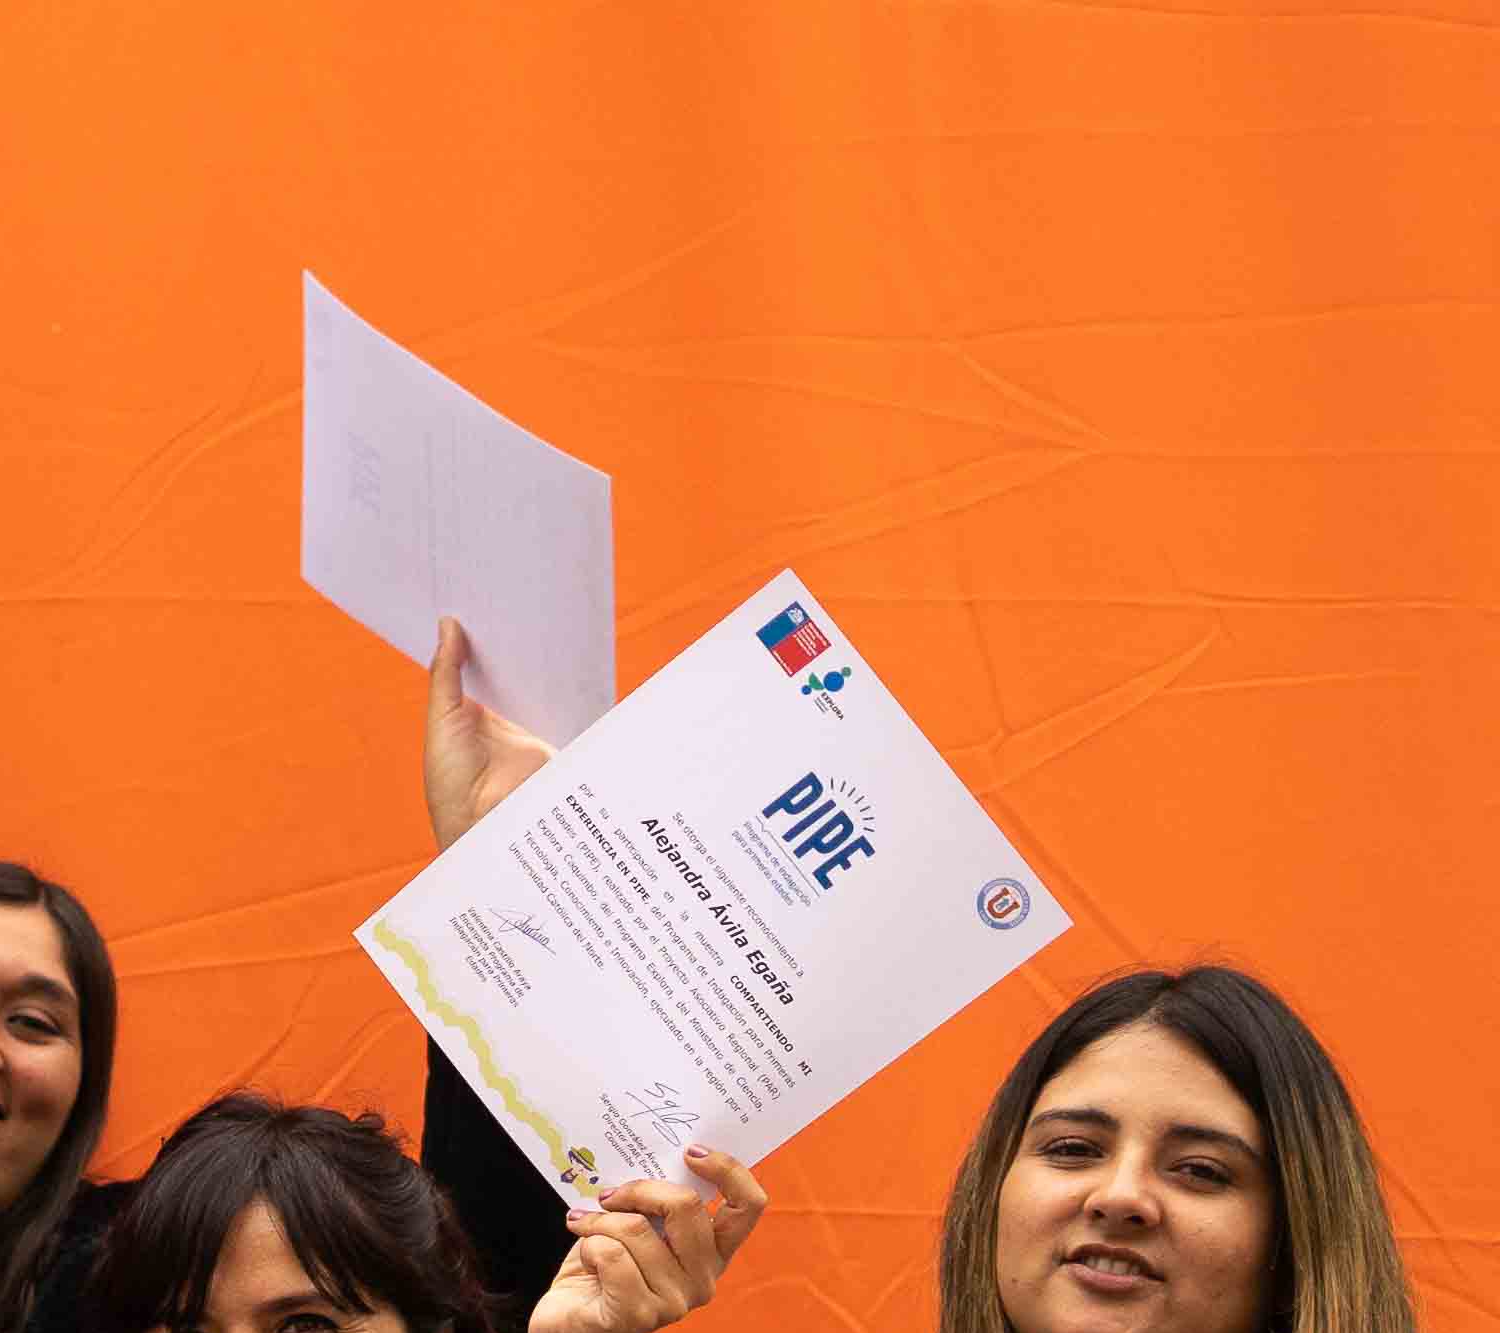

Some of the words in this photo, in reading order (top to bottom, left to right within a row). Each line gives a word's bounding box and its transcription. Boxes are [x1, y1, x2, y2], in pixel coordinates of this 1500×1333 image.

[820, 691, 844, 721] EXPLORA
[640, 818, 712, 902] Alejandra
[708, 905, 752, 948] Ávila
[745, 949, 794, 1005] Egaña
[671, 811, 685, 826] Se
[683, 825, 707, 855] otorga
[705, 855, 717, 865] el
[713, 864, 747, 904] siguiente
[743, 904, 798, 969] reconocimiento
[762, 772, 876, 890] PIPE
[565, 794, 617, 861] EXPERIENCIA
[616, 860, 631, 876] EN
[628, 876, 651, 905] PIPE,
[650, 906, 666, 921] del
[662, 920, 698, 964] Programa
[695, 964, 708, 977] de
[706, 977, 747, 1027] Indagación
[742, 1027, 765, 1049] para
[763, 1048, 796, 1088] Primeras
[578, 783, 595, 798] por
[598, 807, 610, 820] su
[612, 827, 658, 881] participación
[662, 890, 675, 903] en
[679, 910, 693, 922] la
[694, 930, 724, 967] muestra
[729, 975, 794, 1053] COMPARTIENDO
[797, 1060, 813, 1076] MI
